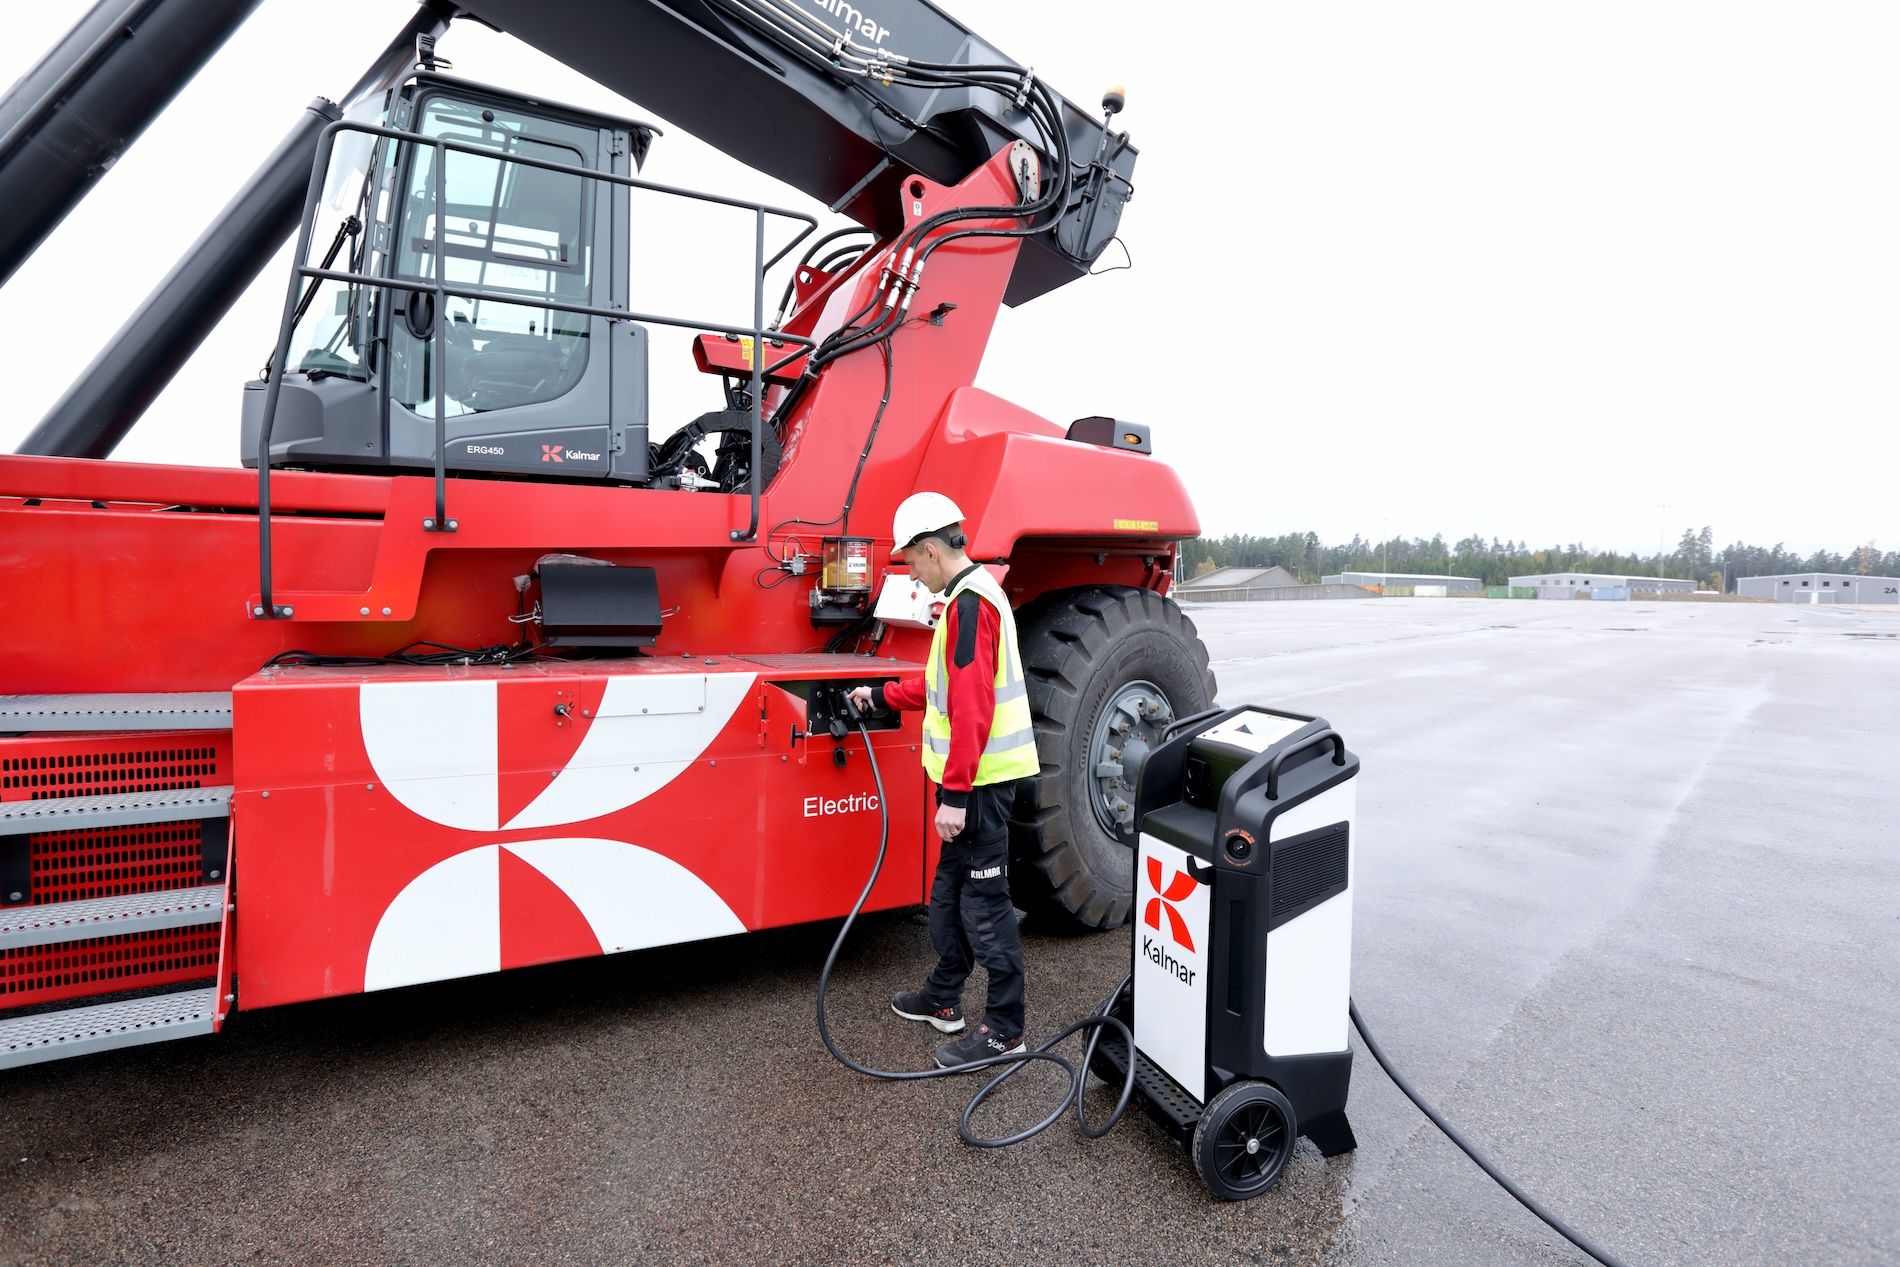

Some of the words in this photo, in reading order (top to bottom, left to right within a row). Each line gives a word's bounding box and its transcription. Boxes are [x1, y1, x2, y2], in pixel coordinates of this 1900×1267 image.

[467, 445, 504, 456] ERG450
[565, 450, 601, 461] Kalmar
[803, 792, 879, 818] Electric
[970, 866, 1001, 880] KALMAR
[1143, 934, 1196, 987] Kalmar
